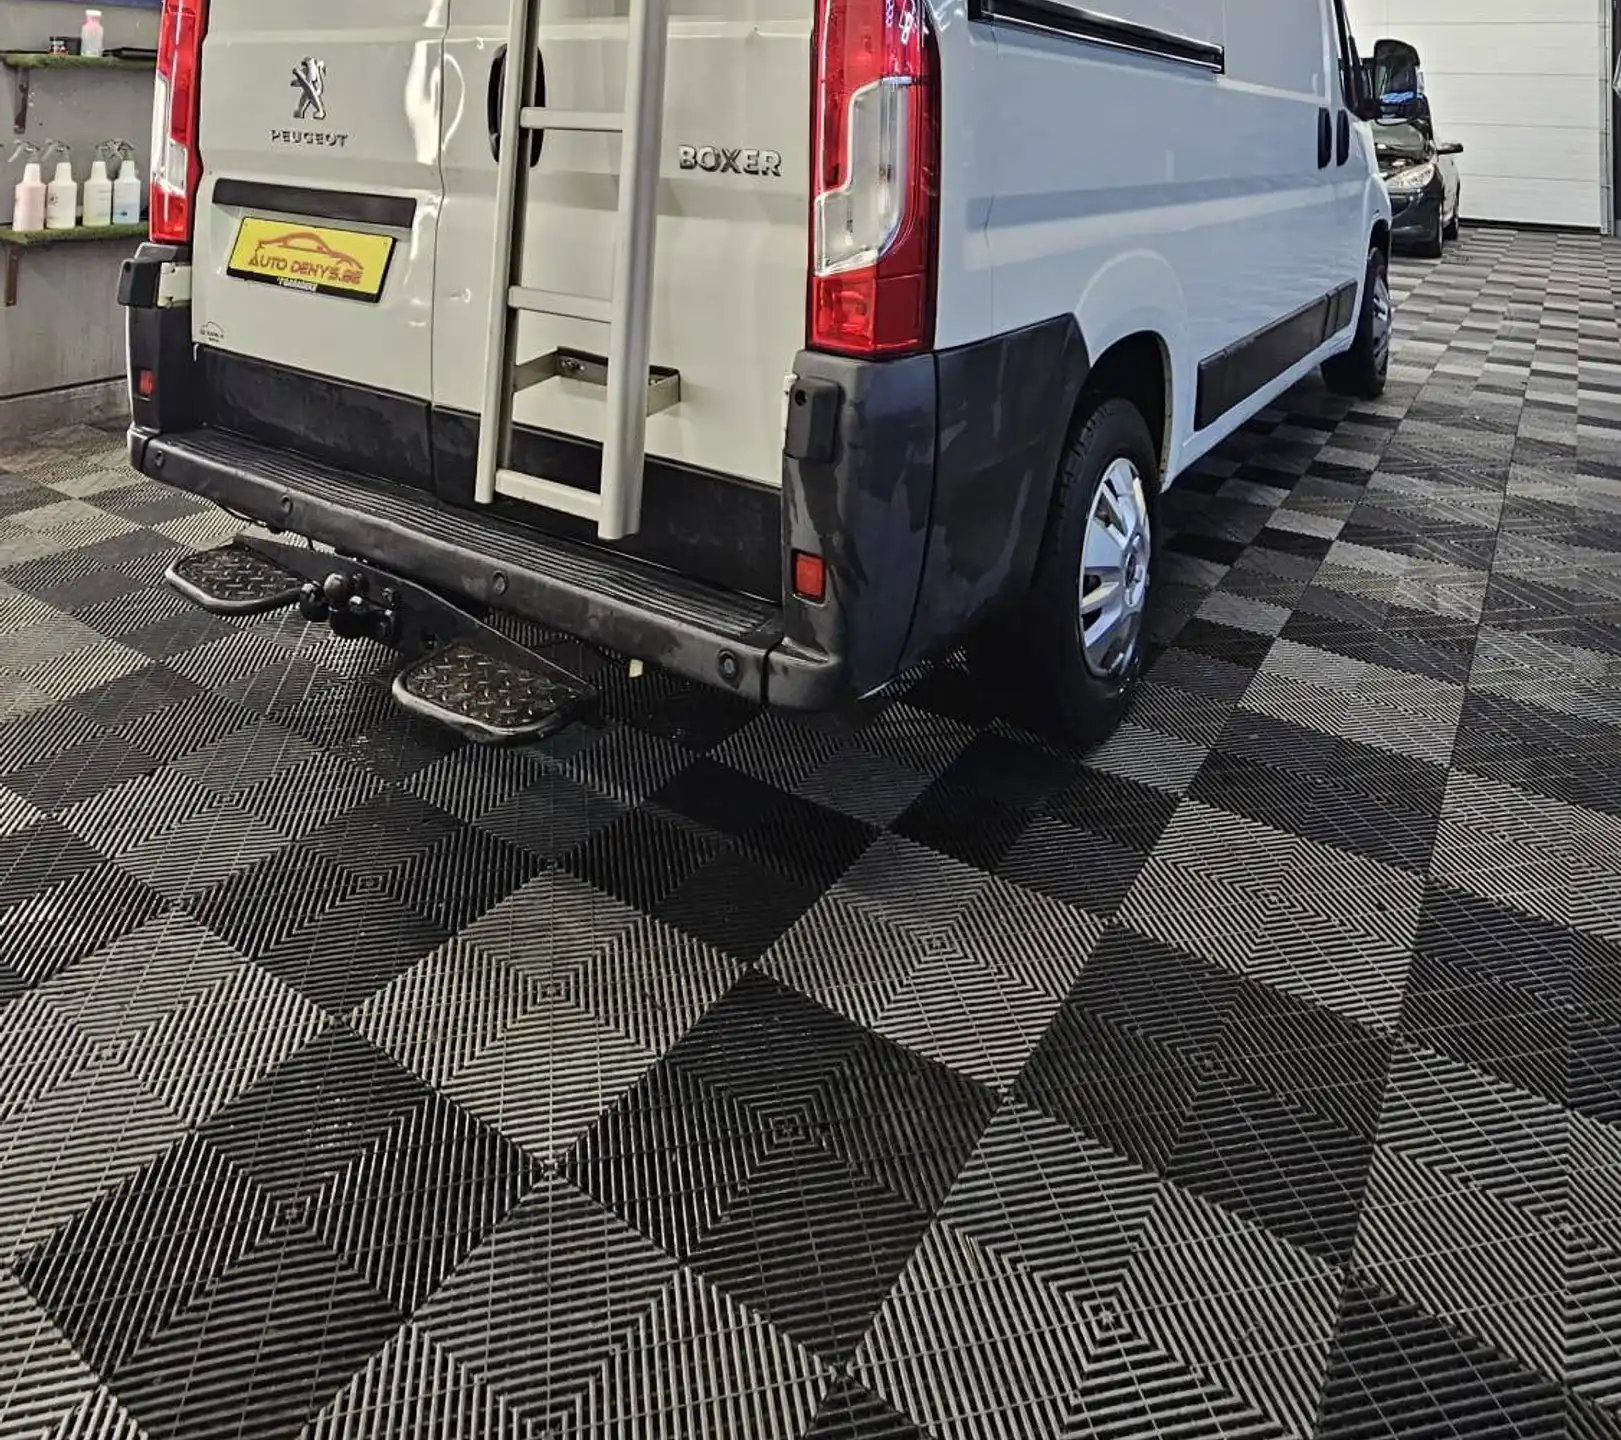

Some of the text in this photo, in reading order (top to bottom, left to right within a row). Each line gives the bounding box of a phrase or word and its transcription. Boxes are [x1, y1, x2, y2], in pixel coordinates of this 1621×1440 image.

[271, 129, 348, 148] PEUGEOT
[678, 143, 782, 177] BOXER
[248, 254, 288, 271] AUTO
[290, 260, 364, 285] DENYS.BE
